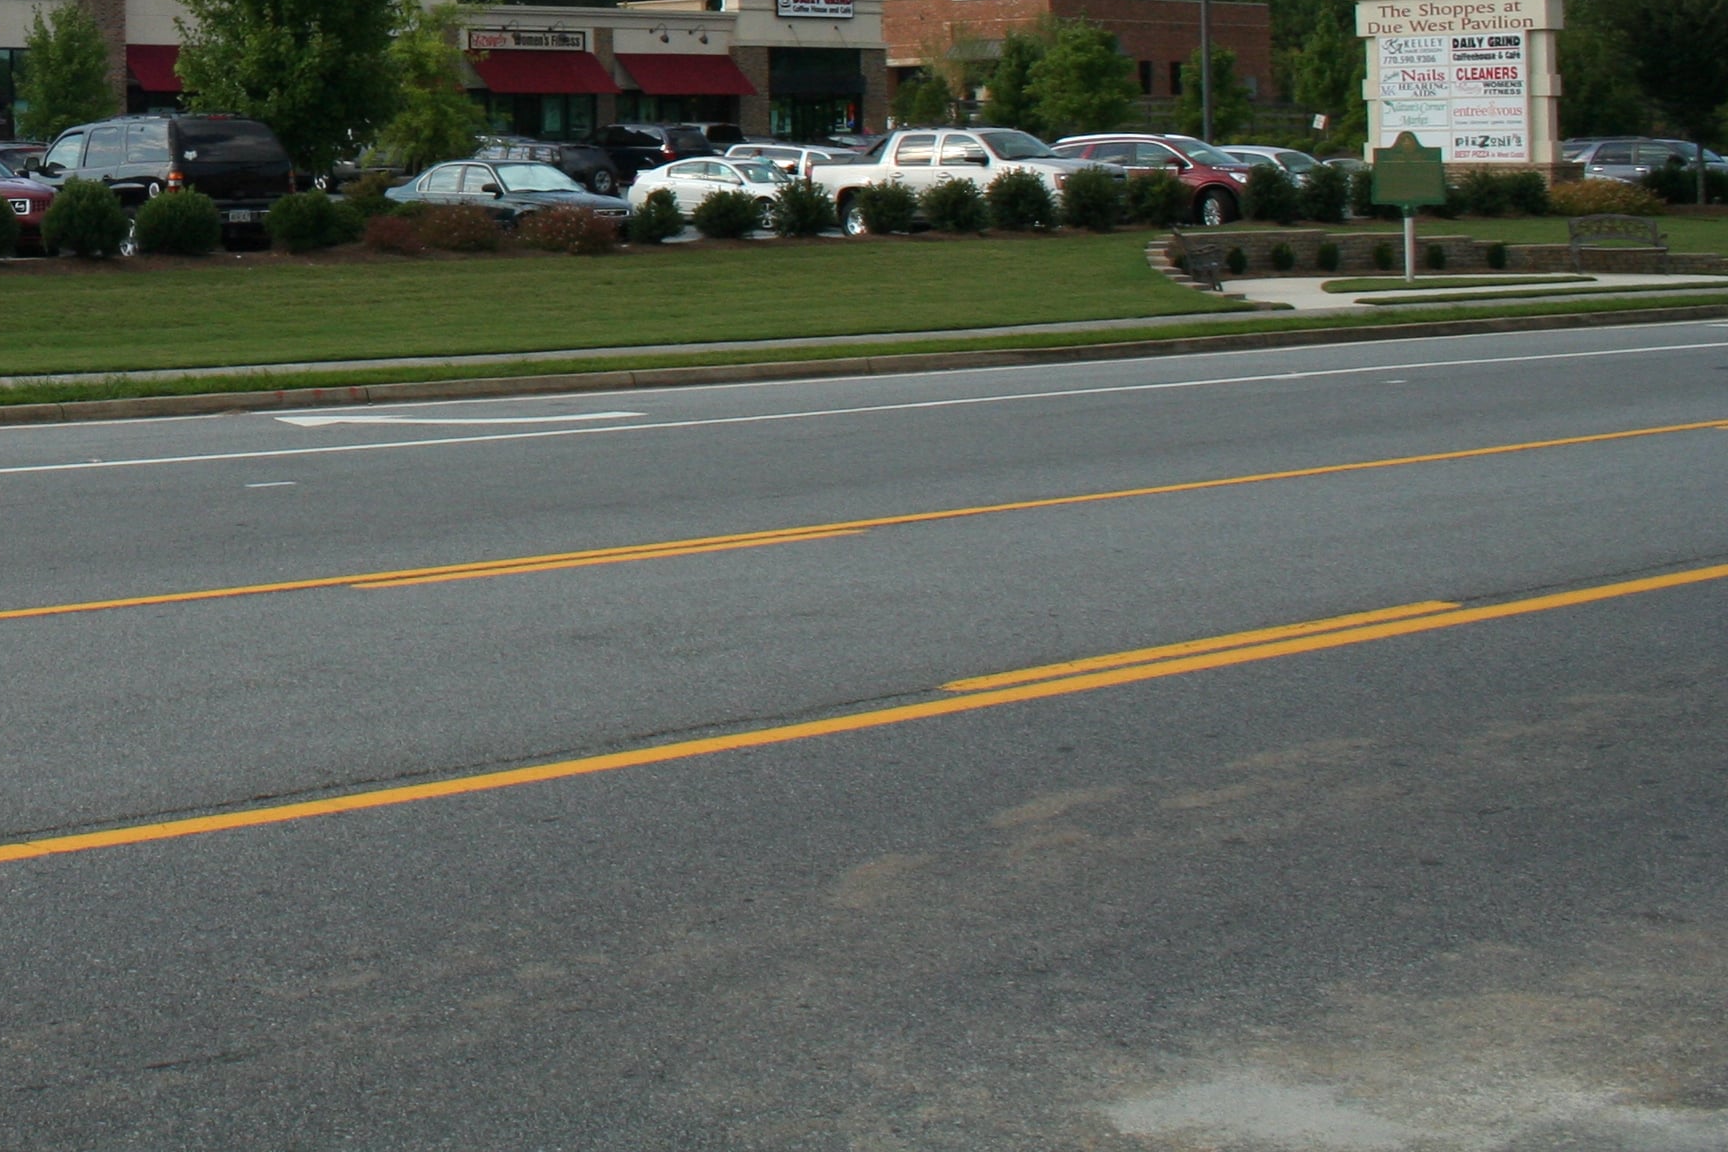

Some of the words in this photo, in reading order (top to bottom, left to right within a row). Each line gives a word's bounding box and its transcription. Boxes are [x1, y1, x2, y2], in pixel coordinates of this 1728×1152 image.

[1377, 4, 1411, 18] The
[1418, 2, 1496, 18] Shoppes
[1503, 1, 1522, 13] at
[1368, 21, 1404, 35] Due
[1410, 19, 1453, 33] West
[1461, 15, 1534, 30] Pavilion
[1404, 38, 1443, 48] KELLEY
[1452, 37, 1483, 49] DAILY
[1487, 36, 1521, 48] GRIND
[1453, 52, 1496, 61] Coffeehouse
[1400, 68, 1446, 82] Nails
[1456, 67, 1519, 81] CLEANERS
[1399, 82, 1448, 91] HEARING
[1413, 89, 1437, 97] AIDS
[1495, 107, 1523, 116] vous
